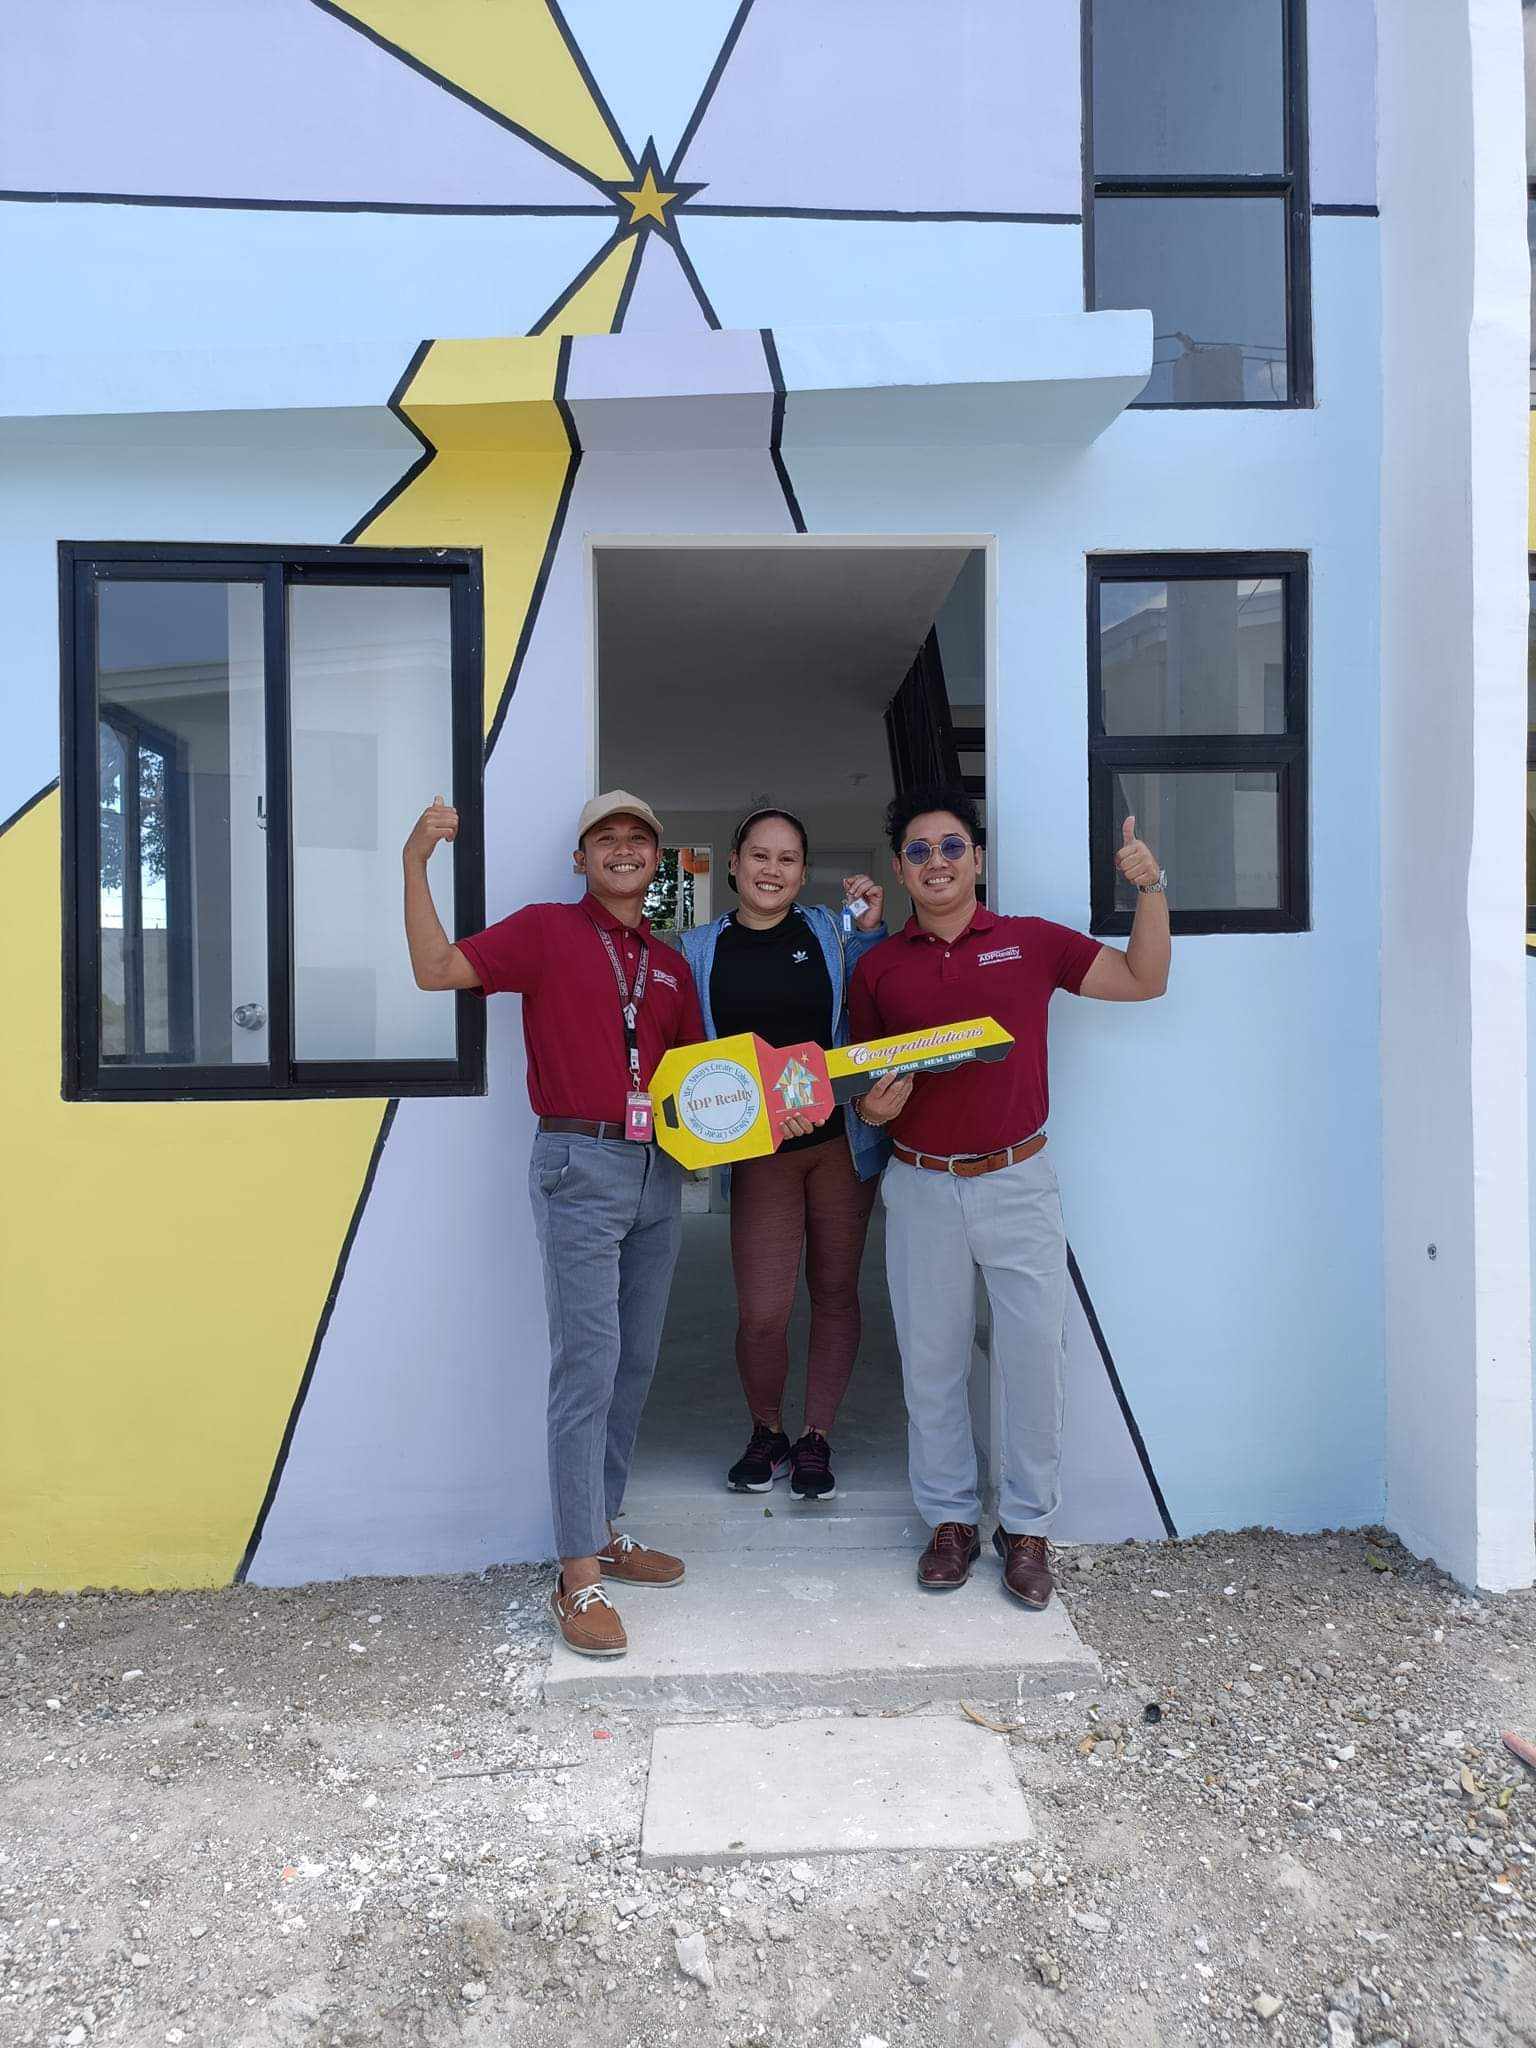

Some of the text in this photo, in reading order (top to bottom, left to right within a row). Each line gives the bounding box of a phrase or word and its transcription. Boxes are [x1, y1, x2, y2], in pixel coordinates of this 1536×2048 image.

[847, 1025, 984, 1065] Congratulations
[870, 1050, 974, 1077] FOR YOUR NEW HOME
[686, 1088, 753, 1113] ADP Realty
